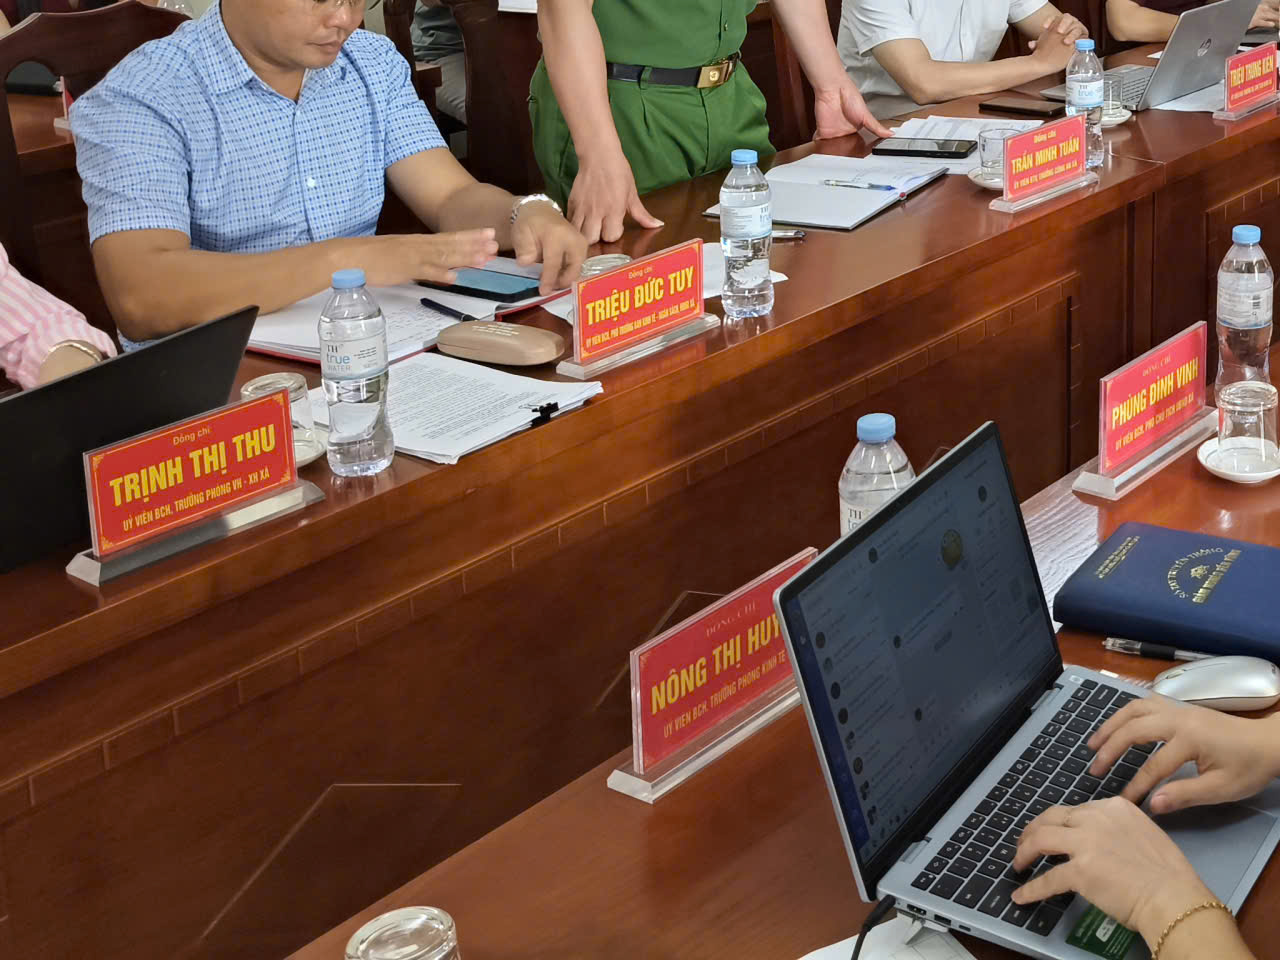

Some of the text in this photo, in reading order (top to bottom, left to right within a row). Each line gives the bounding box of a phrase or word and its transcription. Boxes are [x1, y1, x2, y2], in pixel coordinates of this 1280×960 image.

[1012, 133, 1080, 175] TRẦN MINH TUẤN
[586, 266, 694, 326] TRIỆU ĐỨC TUY
[326, 352, 350, 364] true
[327, 344, 338, 352] TH
[1112, 356, 1199, 430] PHÙNG ĐÌNH VINH
[173, 433, 196, 445] Đồng
[109, 423, 276, 507] TRỊNH THỊ THU
[174, 491, 205, 512] TRƯỞNG
[206, 484, 231, 501] PHÒNG
[232, 477, 243, 491] VH
[249, 472, 259, 484] XH
[651, 656, 707, 715] NÔNG
[712, 634, 741, 675] THỊ
